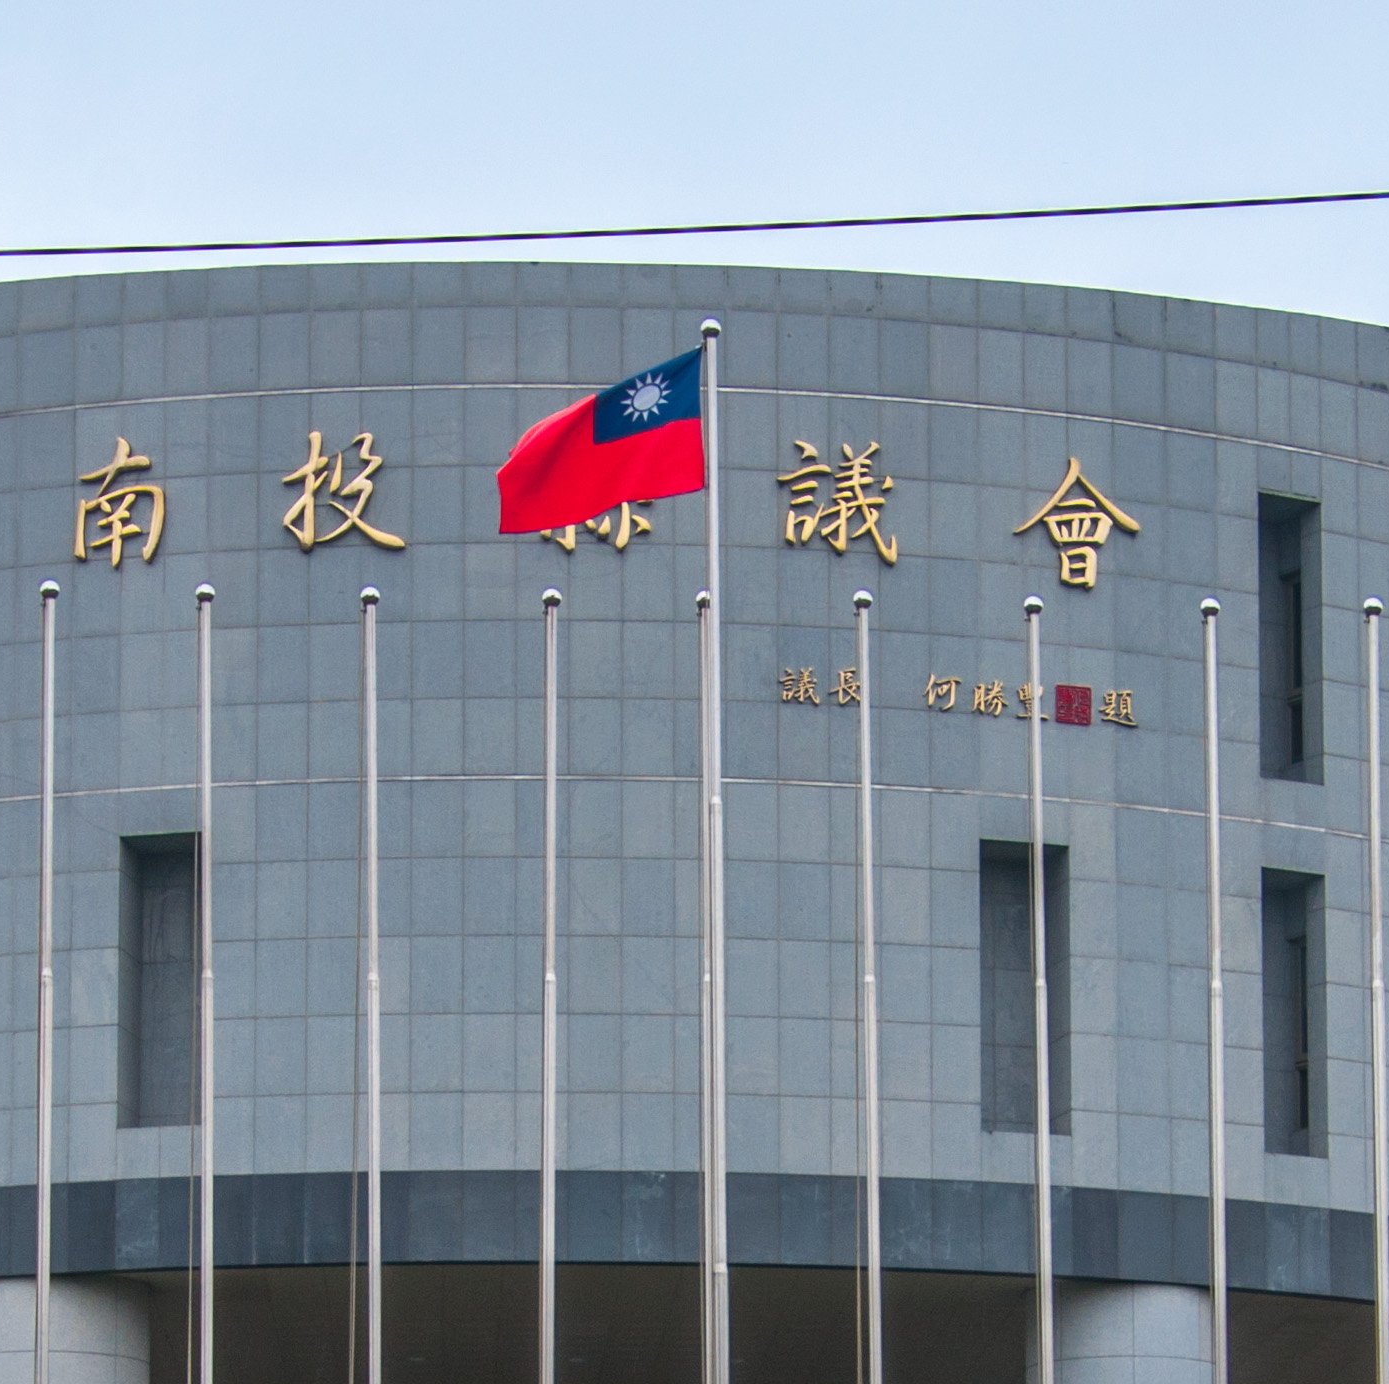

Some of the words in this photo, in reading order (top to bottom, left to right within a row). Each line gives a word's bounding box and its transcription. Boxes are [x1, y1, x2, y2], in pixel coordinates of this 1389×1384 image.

[74, 431, 1141, 591] 南投議會
[779, 667, 860, 706] 議長
[1099, 689, 1138, 727] 題
